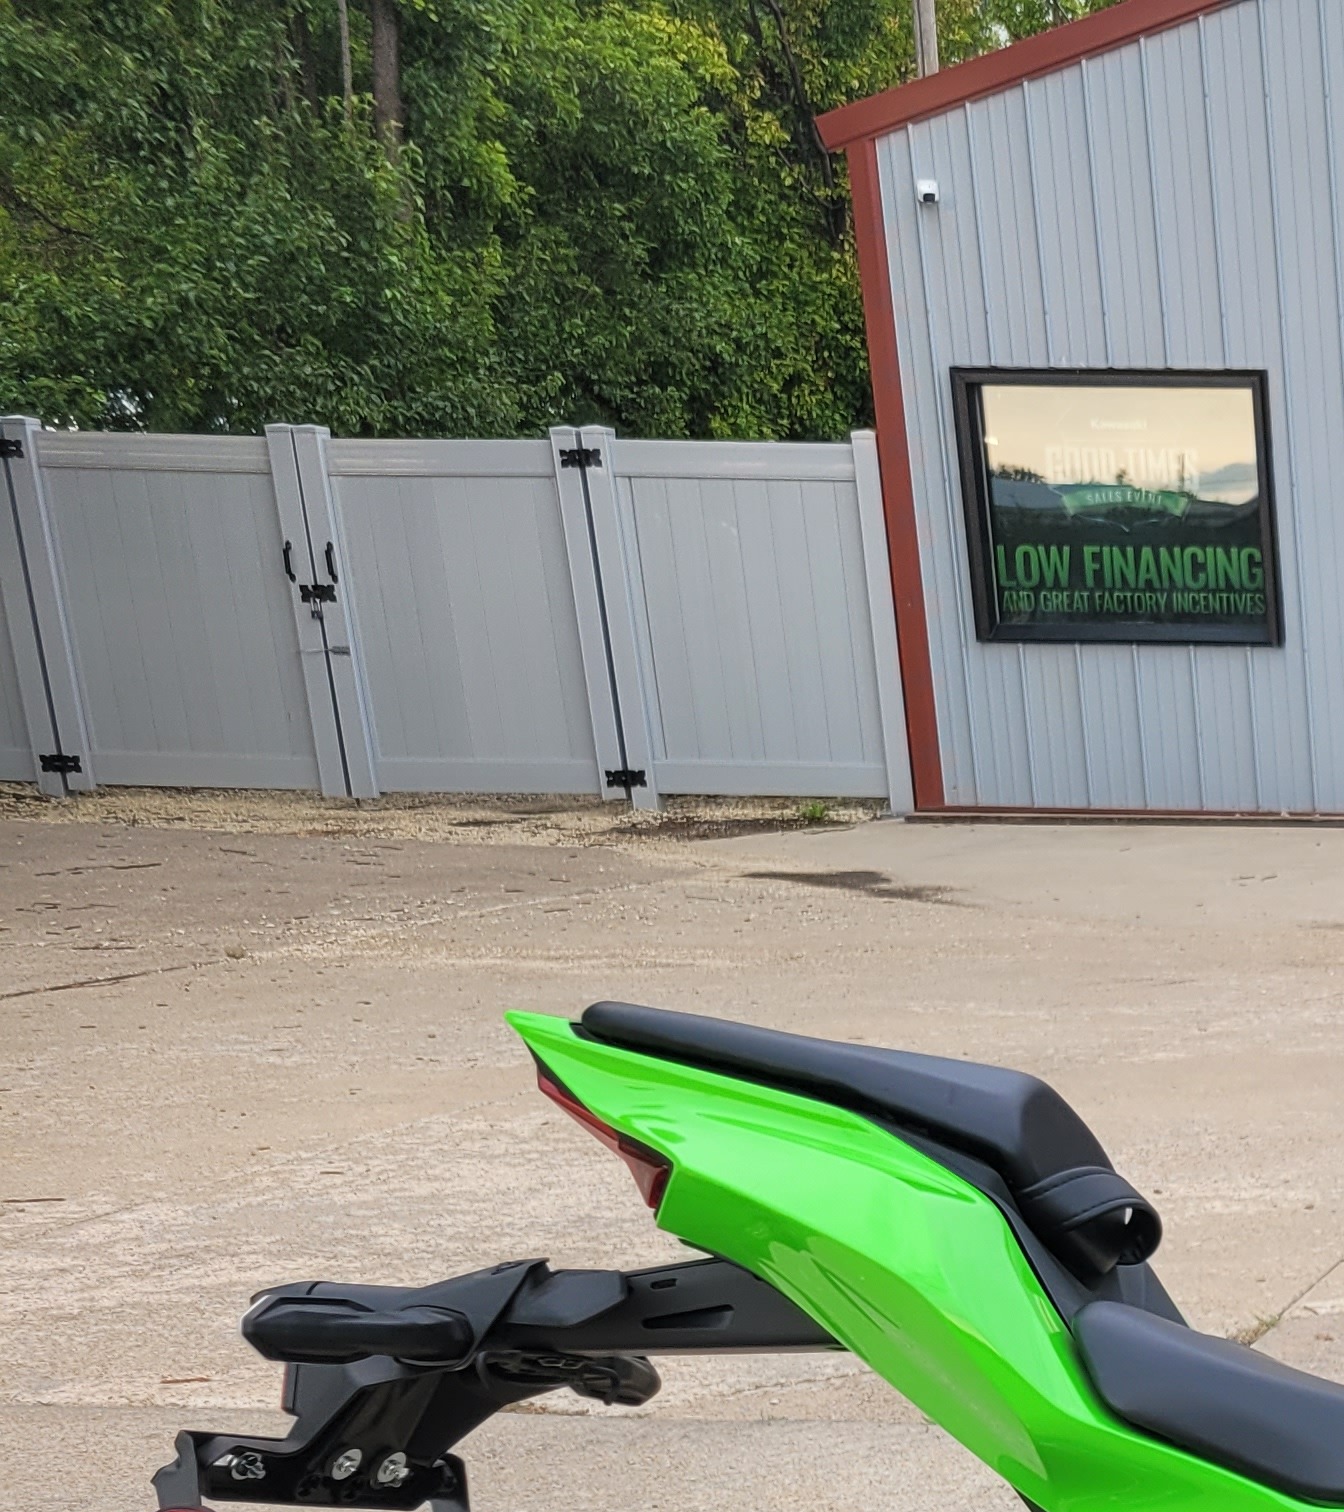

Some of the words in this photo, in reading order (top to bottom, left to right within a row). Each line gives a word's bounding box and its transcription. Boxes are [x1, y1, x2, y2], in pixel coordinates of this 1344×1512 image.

[996, 544, 1071, 590] LOW
[1083, 545, 1265, 591] FINANCING
[1003, 591, 1036, 613] AND
[1041, 591, 1092, 613] GREAT
[1095, 592, 1168, 614] FACTORY
[1173, 592, 1266, 615] INCENTIVES
